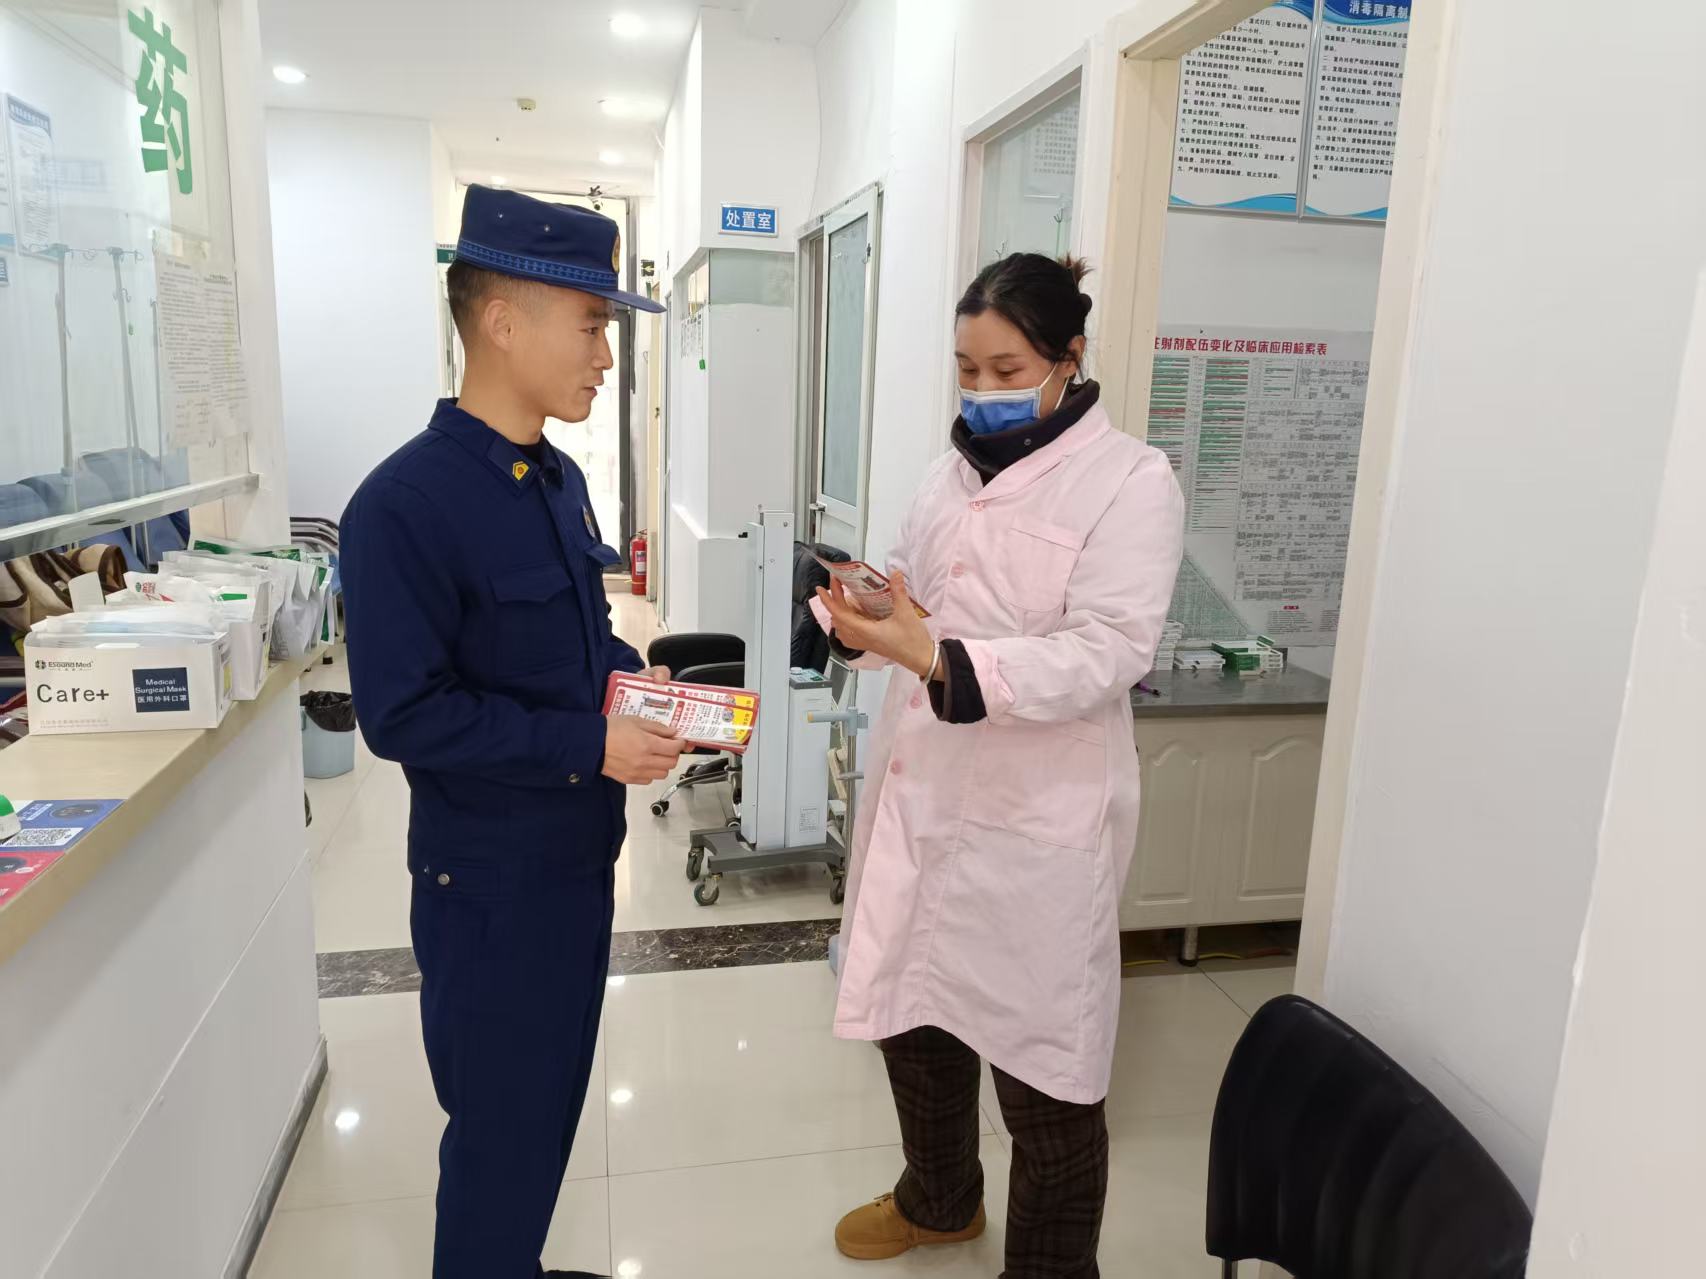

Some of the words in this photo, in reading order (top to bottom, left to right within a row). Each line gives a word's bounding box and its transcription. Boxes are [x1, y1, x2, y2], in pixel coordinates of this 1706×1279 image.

[1349, 0, 1408, 19] 消毒隔离制
[127, 6, 193, 195] 药
[726, 209, 771, 230] 处置室
[36, 684, 109, 703] Care+
[135, 686, 166, 695] Surgical
[166, 685, 187, 693] Mask
[137, 695, 187, 704] 医用外科口罩
